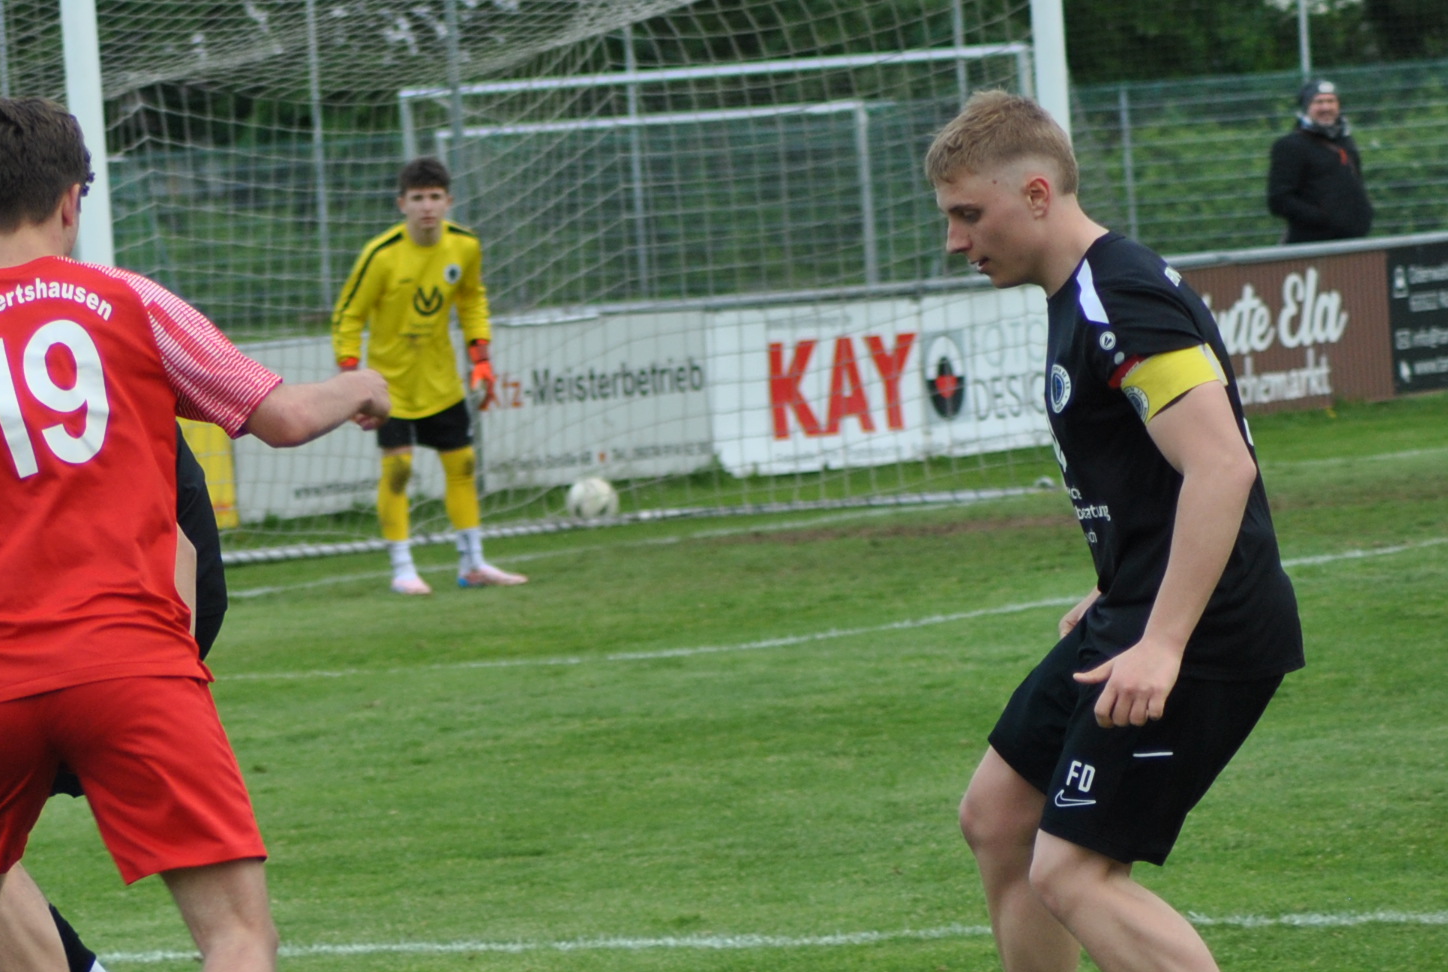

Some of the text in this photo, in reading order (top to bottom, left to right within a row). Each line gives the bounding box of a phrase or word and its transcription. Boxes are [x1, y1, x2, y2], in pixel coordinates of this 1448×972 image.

[1278, 267, 1349, 348] Ela
[768, 333, 917, 440] KAY
[973, 371, 1046, 421] DESIG
[1066, 760, 1095, 793] FD
